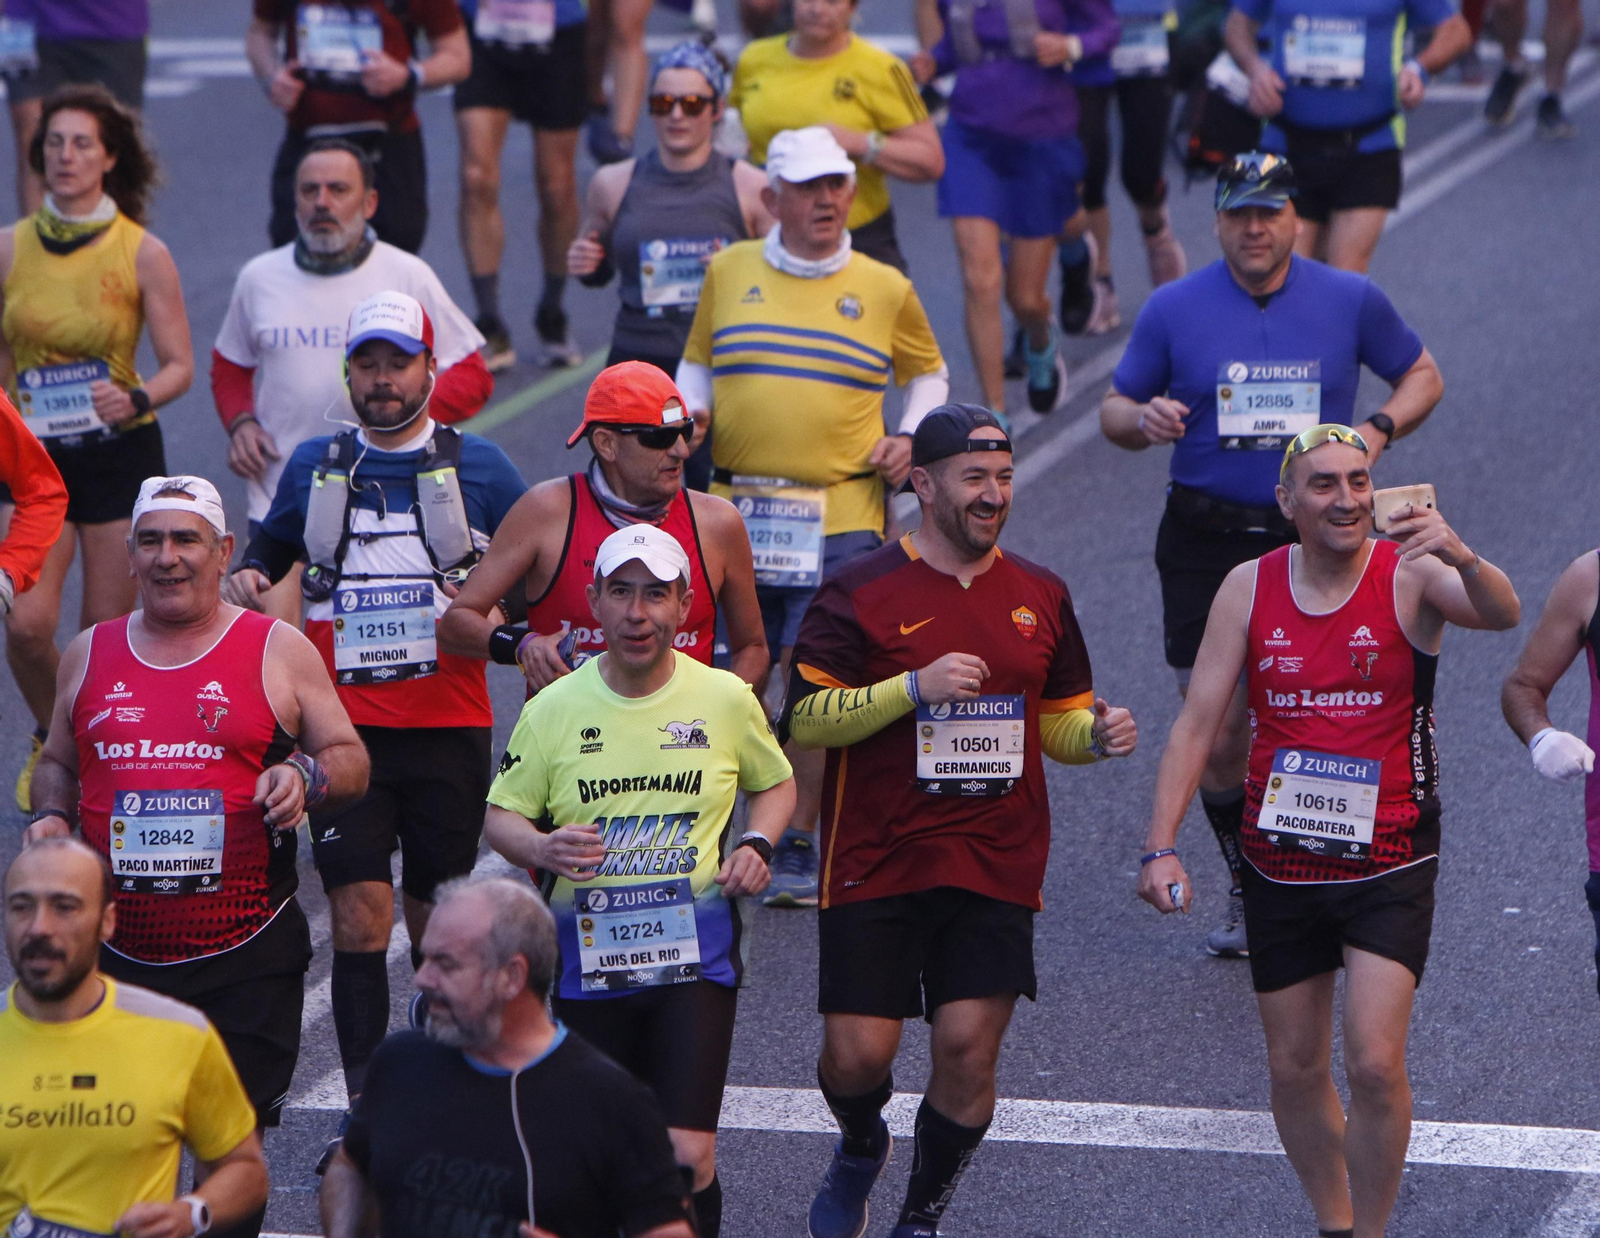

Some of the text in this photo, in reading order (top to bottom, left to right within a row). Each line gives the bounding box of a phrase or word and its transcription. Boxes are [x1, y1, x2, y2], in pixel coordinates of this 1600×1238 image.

[44, 364, 98, 385] ZURICH
[1251, 366, 1308, 379] ZURICH
[1246, 394, 1294, 409] 12885
[756, 502, 809, 518] ZURICH
[361, 590, 421, 607] ZURICH
[357, 621, 406, 639] 12151
[360, 649, 408, 663] MIGNON
[1266, 689, 1384, 707] Los Lentos
[849, 704, 877, 720] CROSS
[955, 702, 1013, 715] ZURICH
[94, 739, 226, 760] Los Lentos
[950, 737, 1000, 752] 10501
[1411, 705, 1426, 782] vivenzia
[934, 762, 1012, 774] GERMANICUS
[1304, 757, 1368, 779] ZURICH
[577, 770, 703, 804] DEPORTEMANIA
[144, 796, 210, 811] ZURICH
[1294, 792, 1348, 814] 10615
[1275, 814, 1356, 837] PACOBATERA
[138, 829, 194, 846] 12842
[118, 856, 215, 872] PACO MARTÍNEZ
[578, 846, 698, 877] UNNERS
[609, 921, 665, 941] 12724
[599, 948, 680, 967] LUIS DEL RIO
[673, 976, 698, 984] ZURICH
[0, 1102, 136, 1129] Sevilla10
